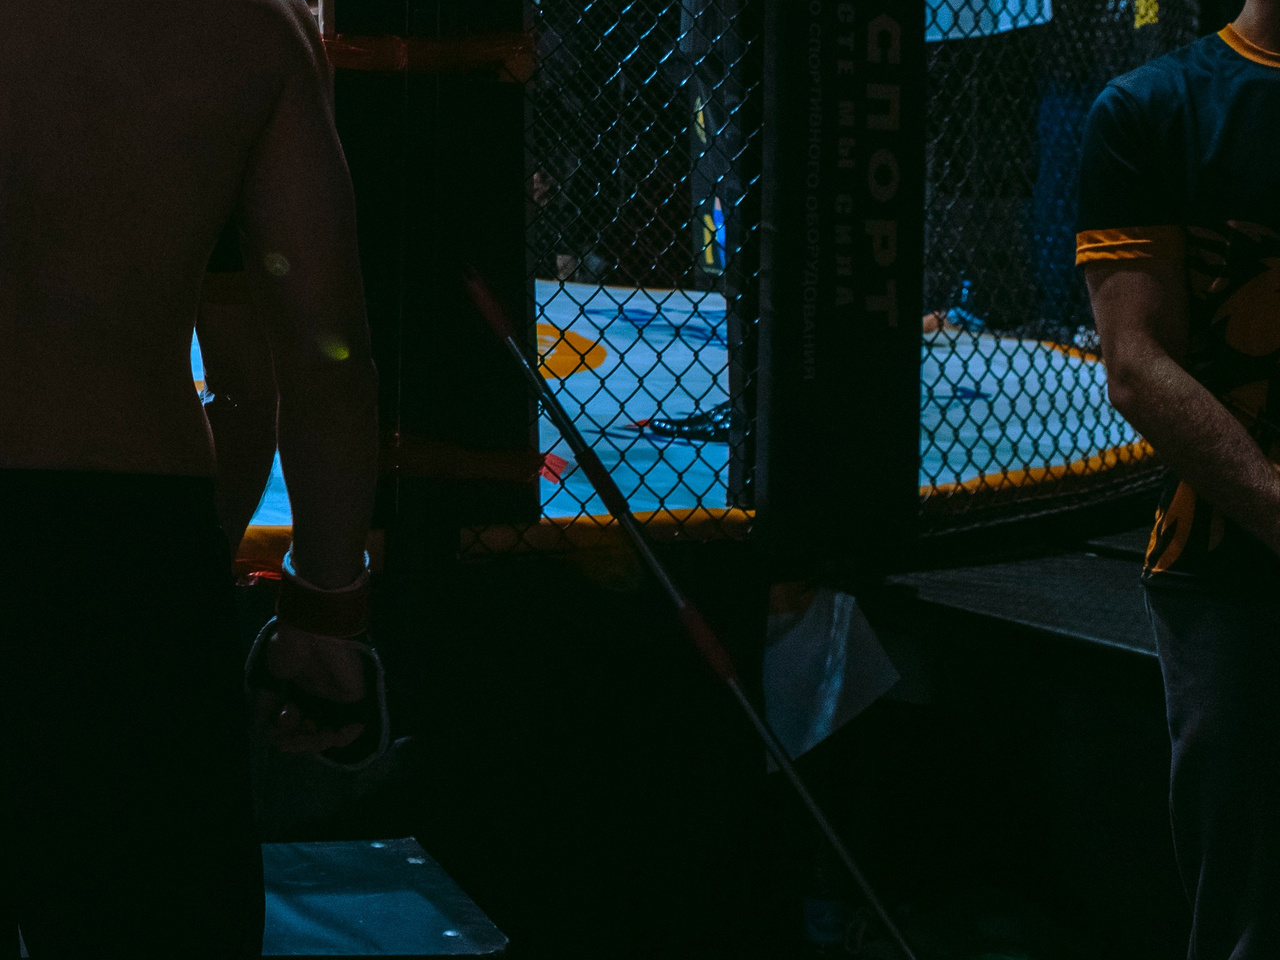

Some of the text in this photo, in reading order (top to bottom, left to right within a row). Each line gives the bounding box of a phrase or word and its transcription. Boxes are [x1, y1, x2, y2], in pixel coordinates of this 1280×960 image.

[806, 21, 824, 189] СПОРТИВНОГО
[836, 99, 857, 170] МЫ
[802, 194, 821, 381] ОБОРУДОВАНИЯ
[833, 193, 855, 307] СИЛА
